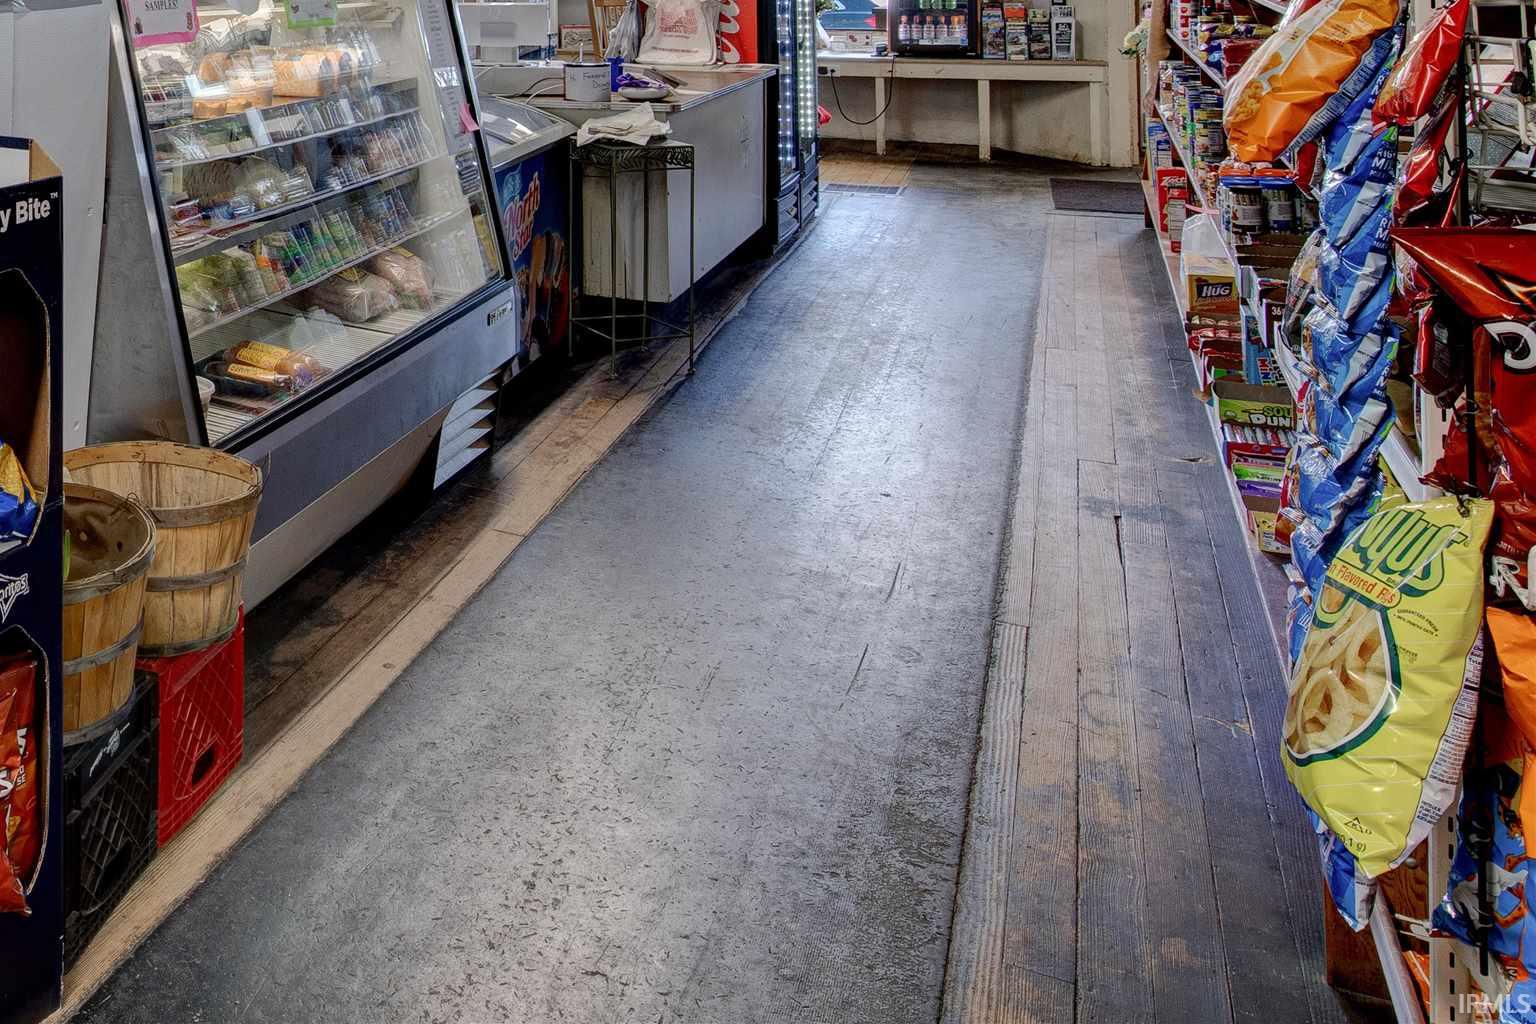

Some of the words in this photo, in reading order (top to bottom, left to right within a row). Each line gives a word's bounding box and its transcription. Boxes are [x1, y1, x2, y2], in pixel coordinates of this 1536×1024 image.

[144, 0, 179, 12] SAMPLES!
[15, 197, 51, 225] Bite
[1338, 563, 1377, 595] Flavored
